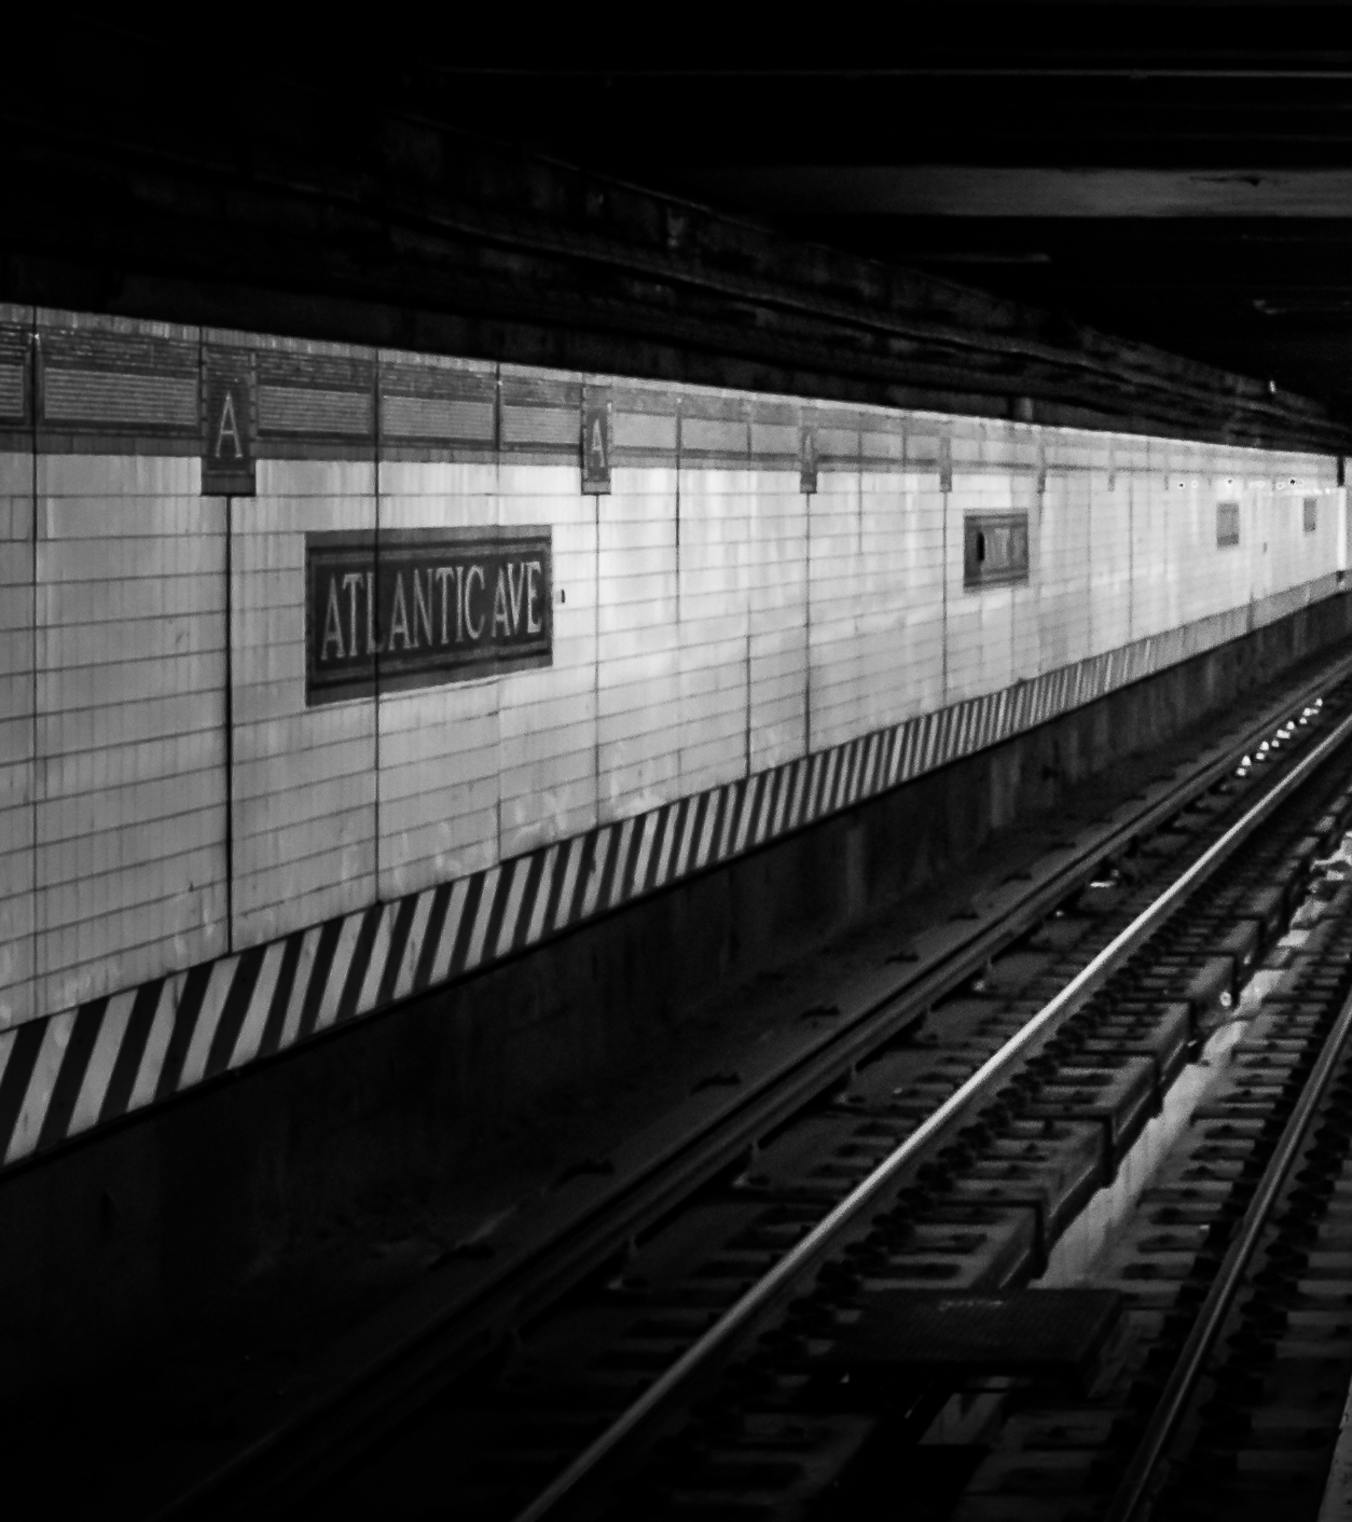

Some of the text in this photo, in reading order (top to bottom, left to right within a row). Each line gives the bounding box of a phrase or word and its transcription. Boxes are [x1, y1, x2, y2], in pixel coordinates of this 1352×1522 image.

[215, 390, 243, 459] A
[590, 418, 605, 469] A
[320, 560, 543, 661] ATLANTIC AVE
